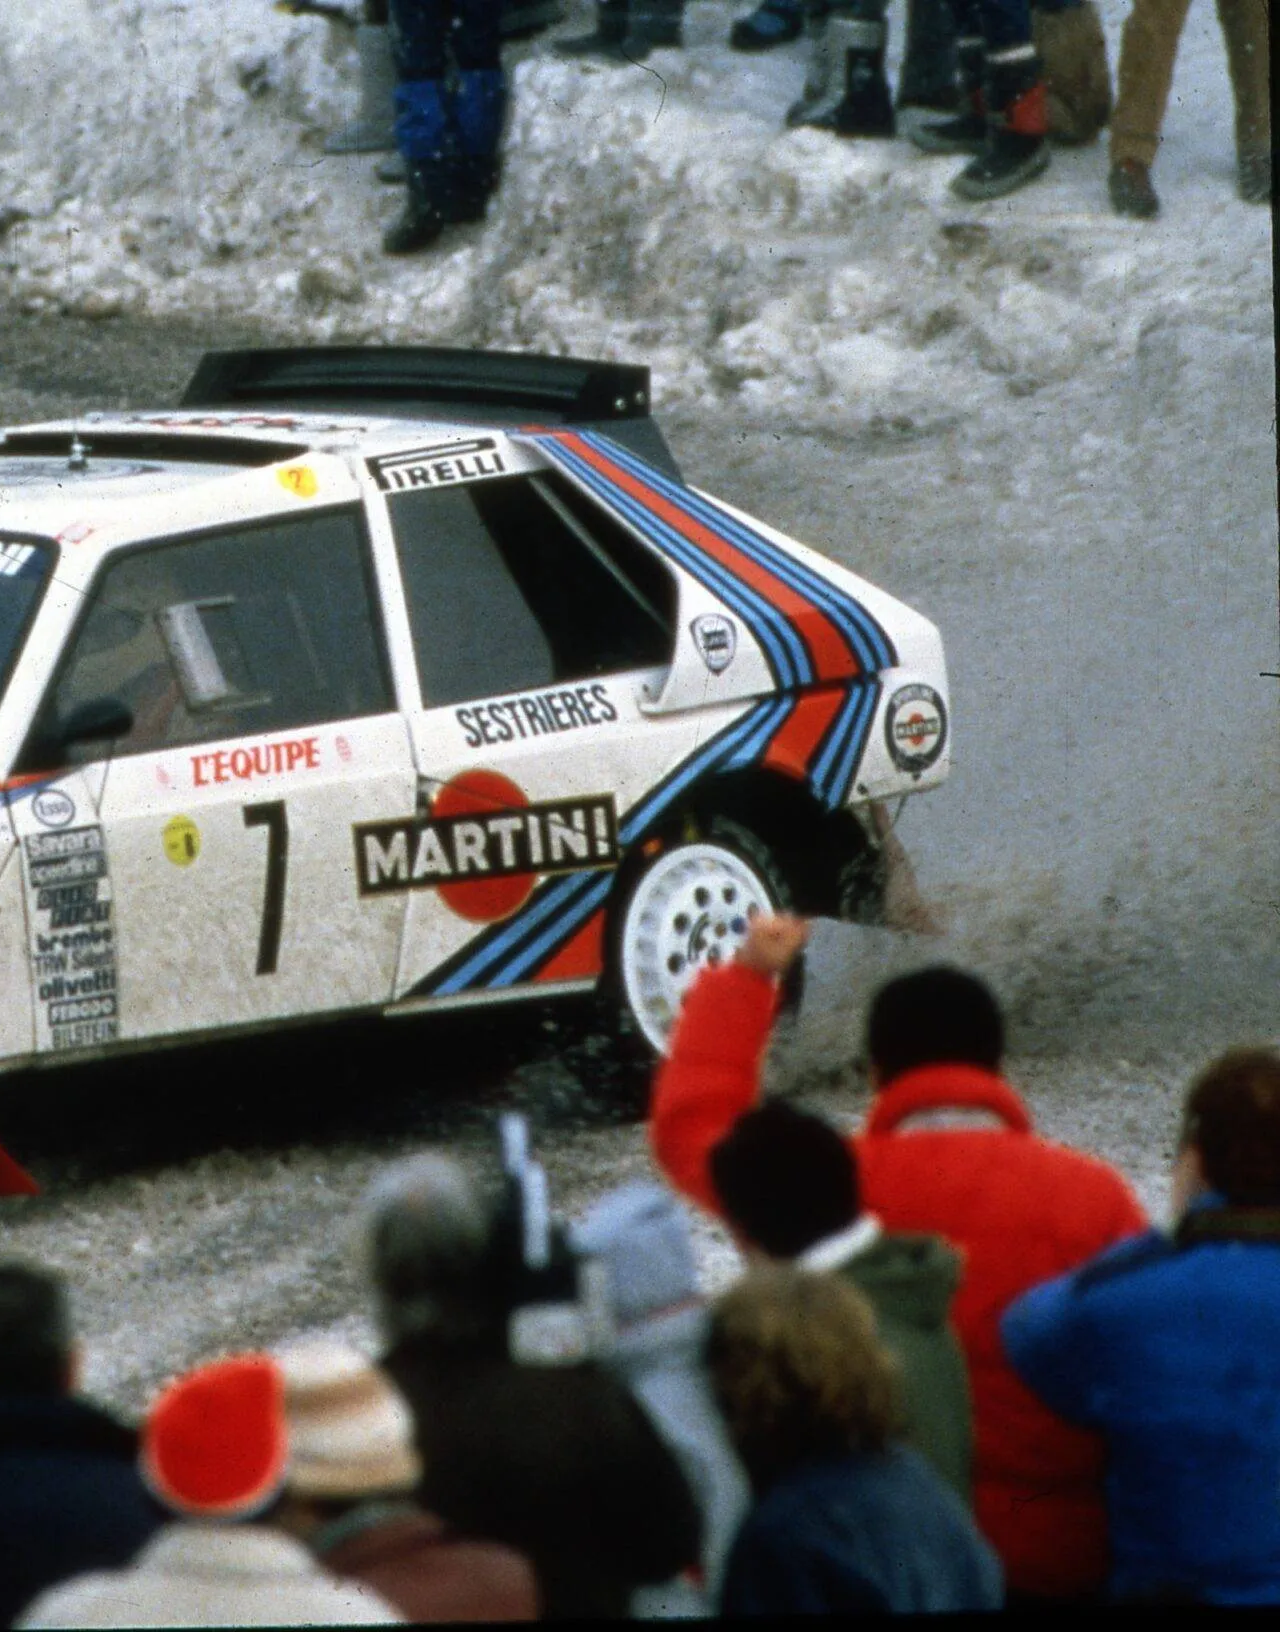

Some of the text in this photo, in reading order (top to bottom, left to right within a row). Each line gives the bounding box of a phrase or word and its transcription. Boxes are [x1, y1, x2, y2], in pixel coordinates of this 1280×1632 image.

[365, 438, 505, 490] PIRELLI
[456, 684, 618, 748] SESTRIERES
[363, 806, 609, 886] MARTINI
[243, 799, 289, 976] 7
[39, 968, 116, 999] olivetti
